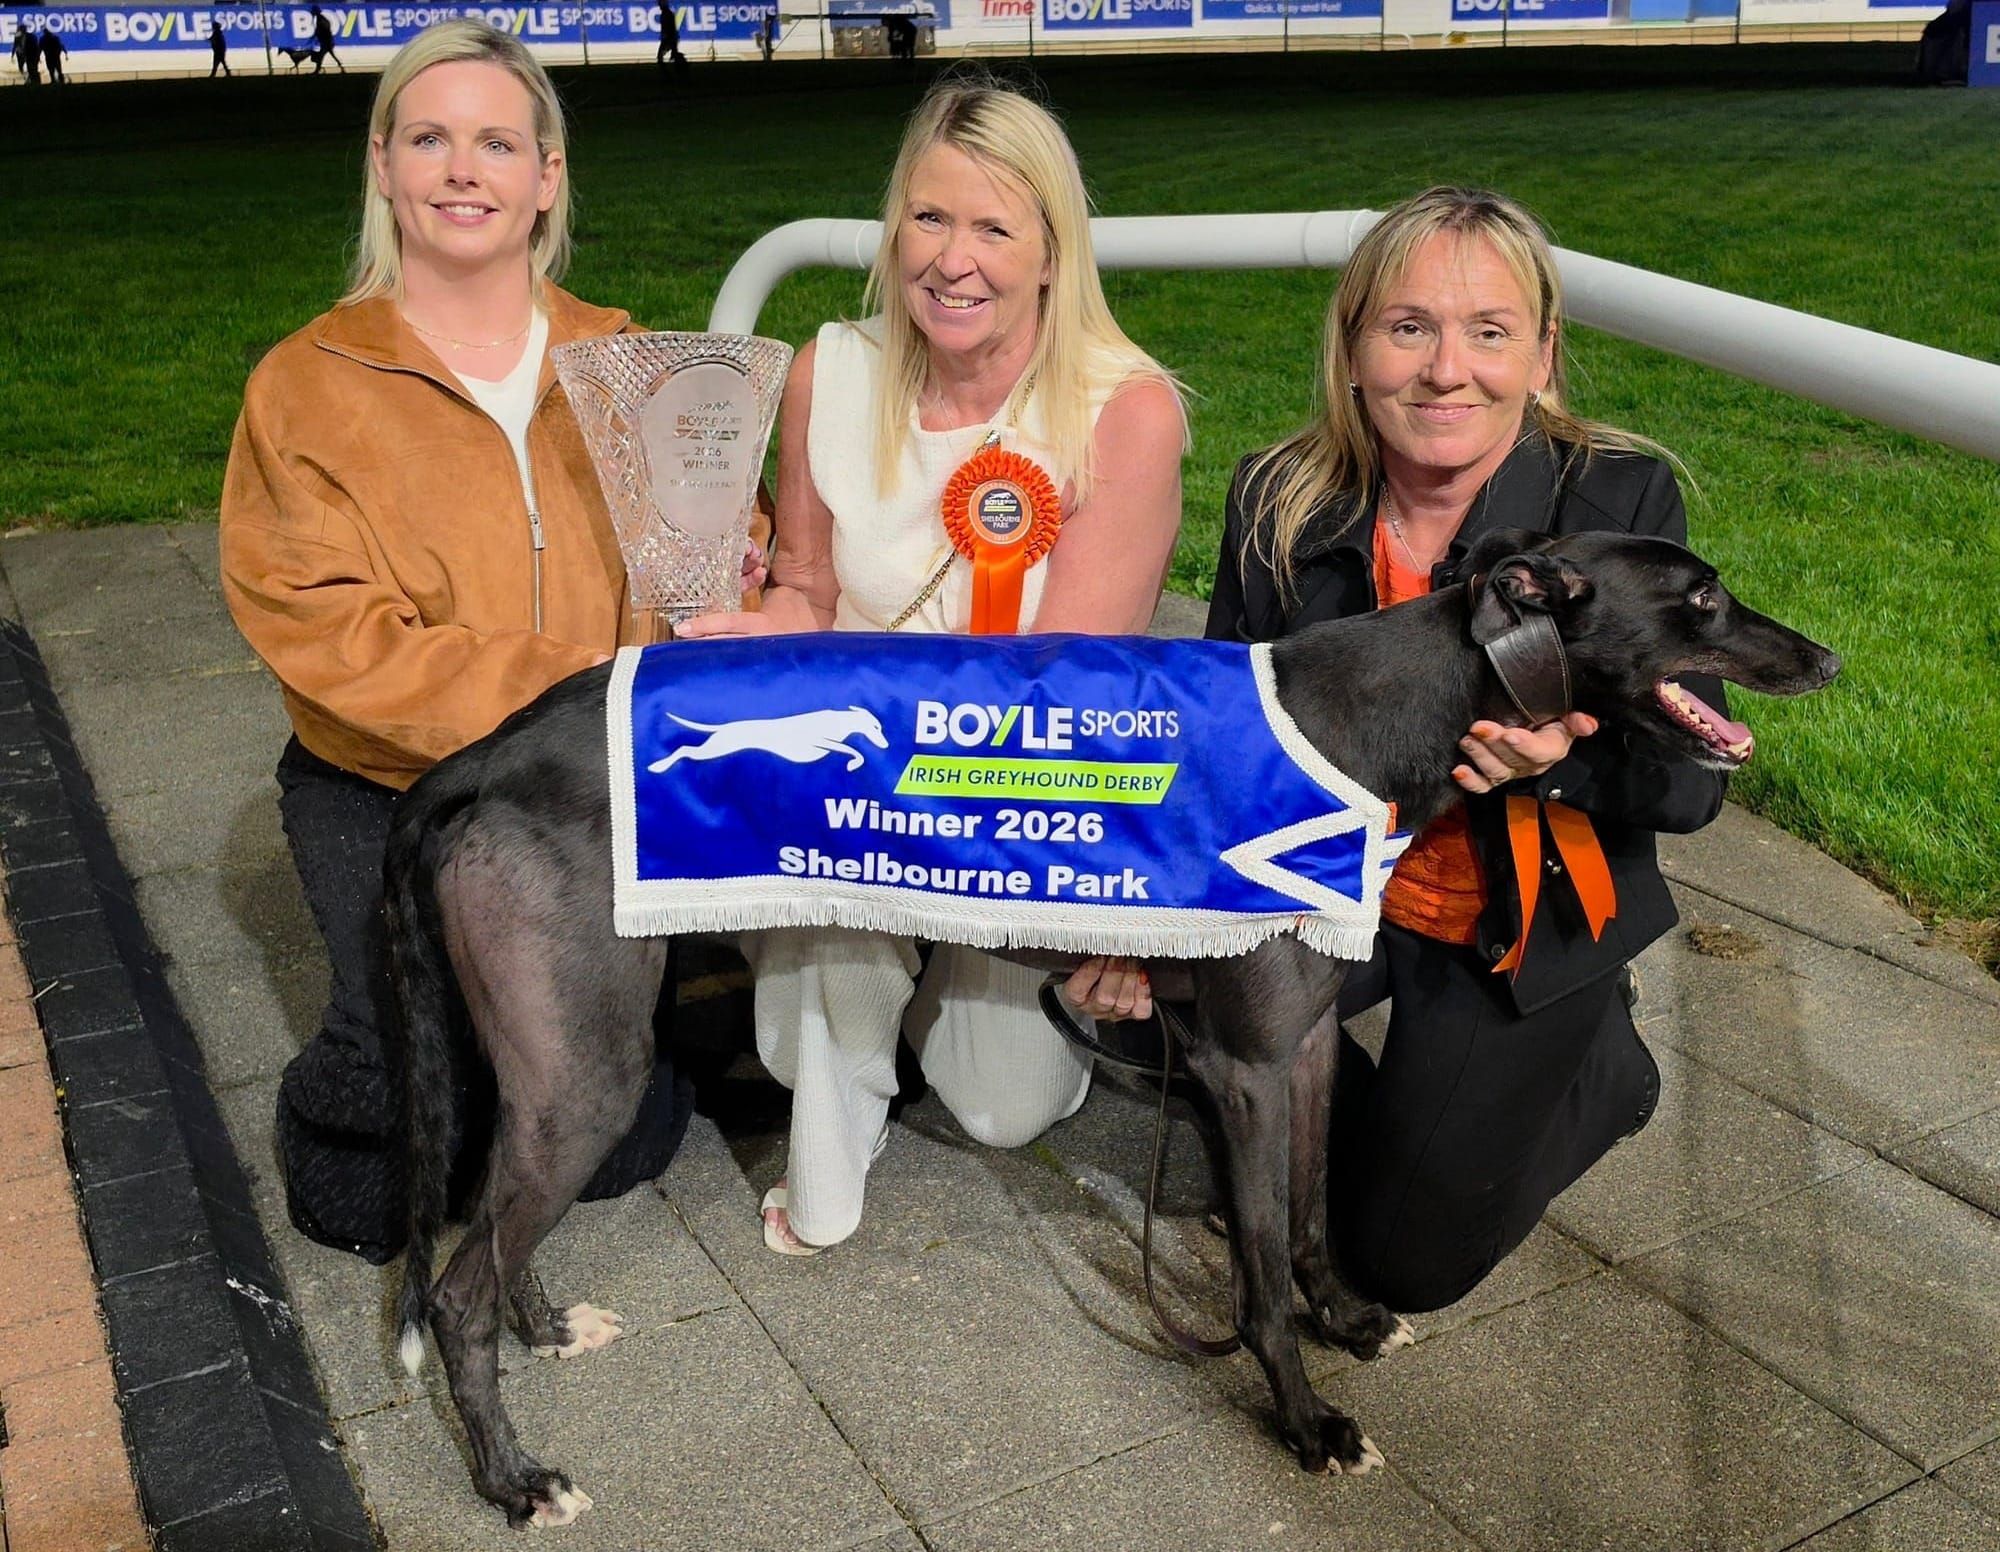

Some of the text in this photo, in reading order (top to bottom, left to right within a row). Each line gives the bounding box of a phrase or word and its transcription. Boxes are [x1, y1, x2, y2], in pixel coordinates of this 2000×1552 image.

[22, 12, 98, 33] SPORTS
[560, 7, 624, 26] SPORTS
[1047, 0, 1132, 20] BOYLE
[104, 11, 281, 42] BOYLE SPORTS
[914, 700, 1180, 751] BOYLE SPORTS
[908, 766, 1165, 792] IRISH GREYHOUND DERBY
[824, 798, 1104, 844] Winner 2026
[778, 845, 1150, 900] Shelbourne Park
